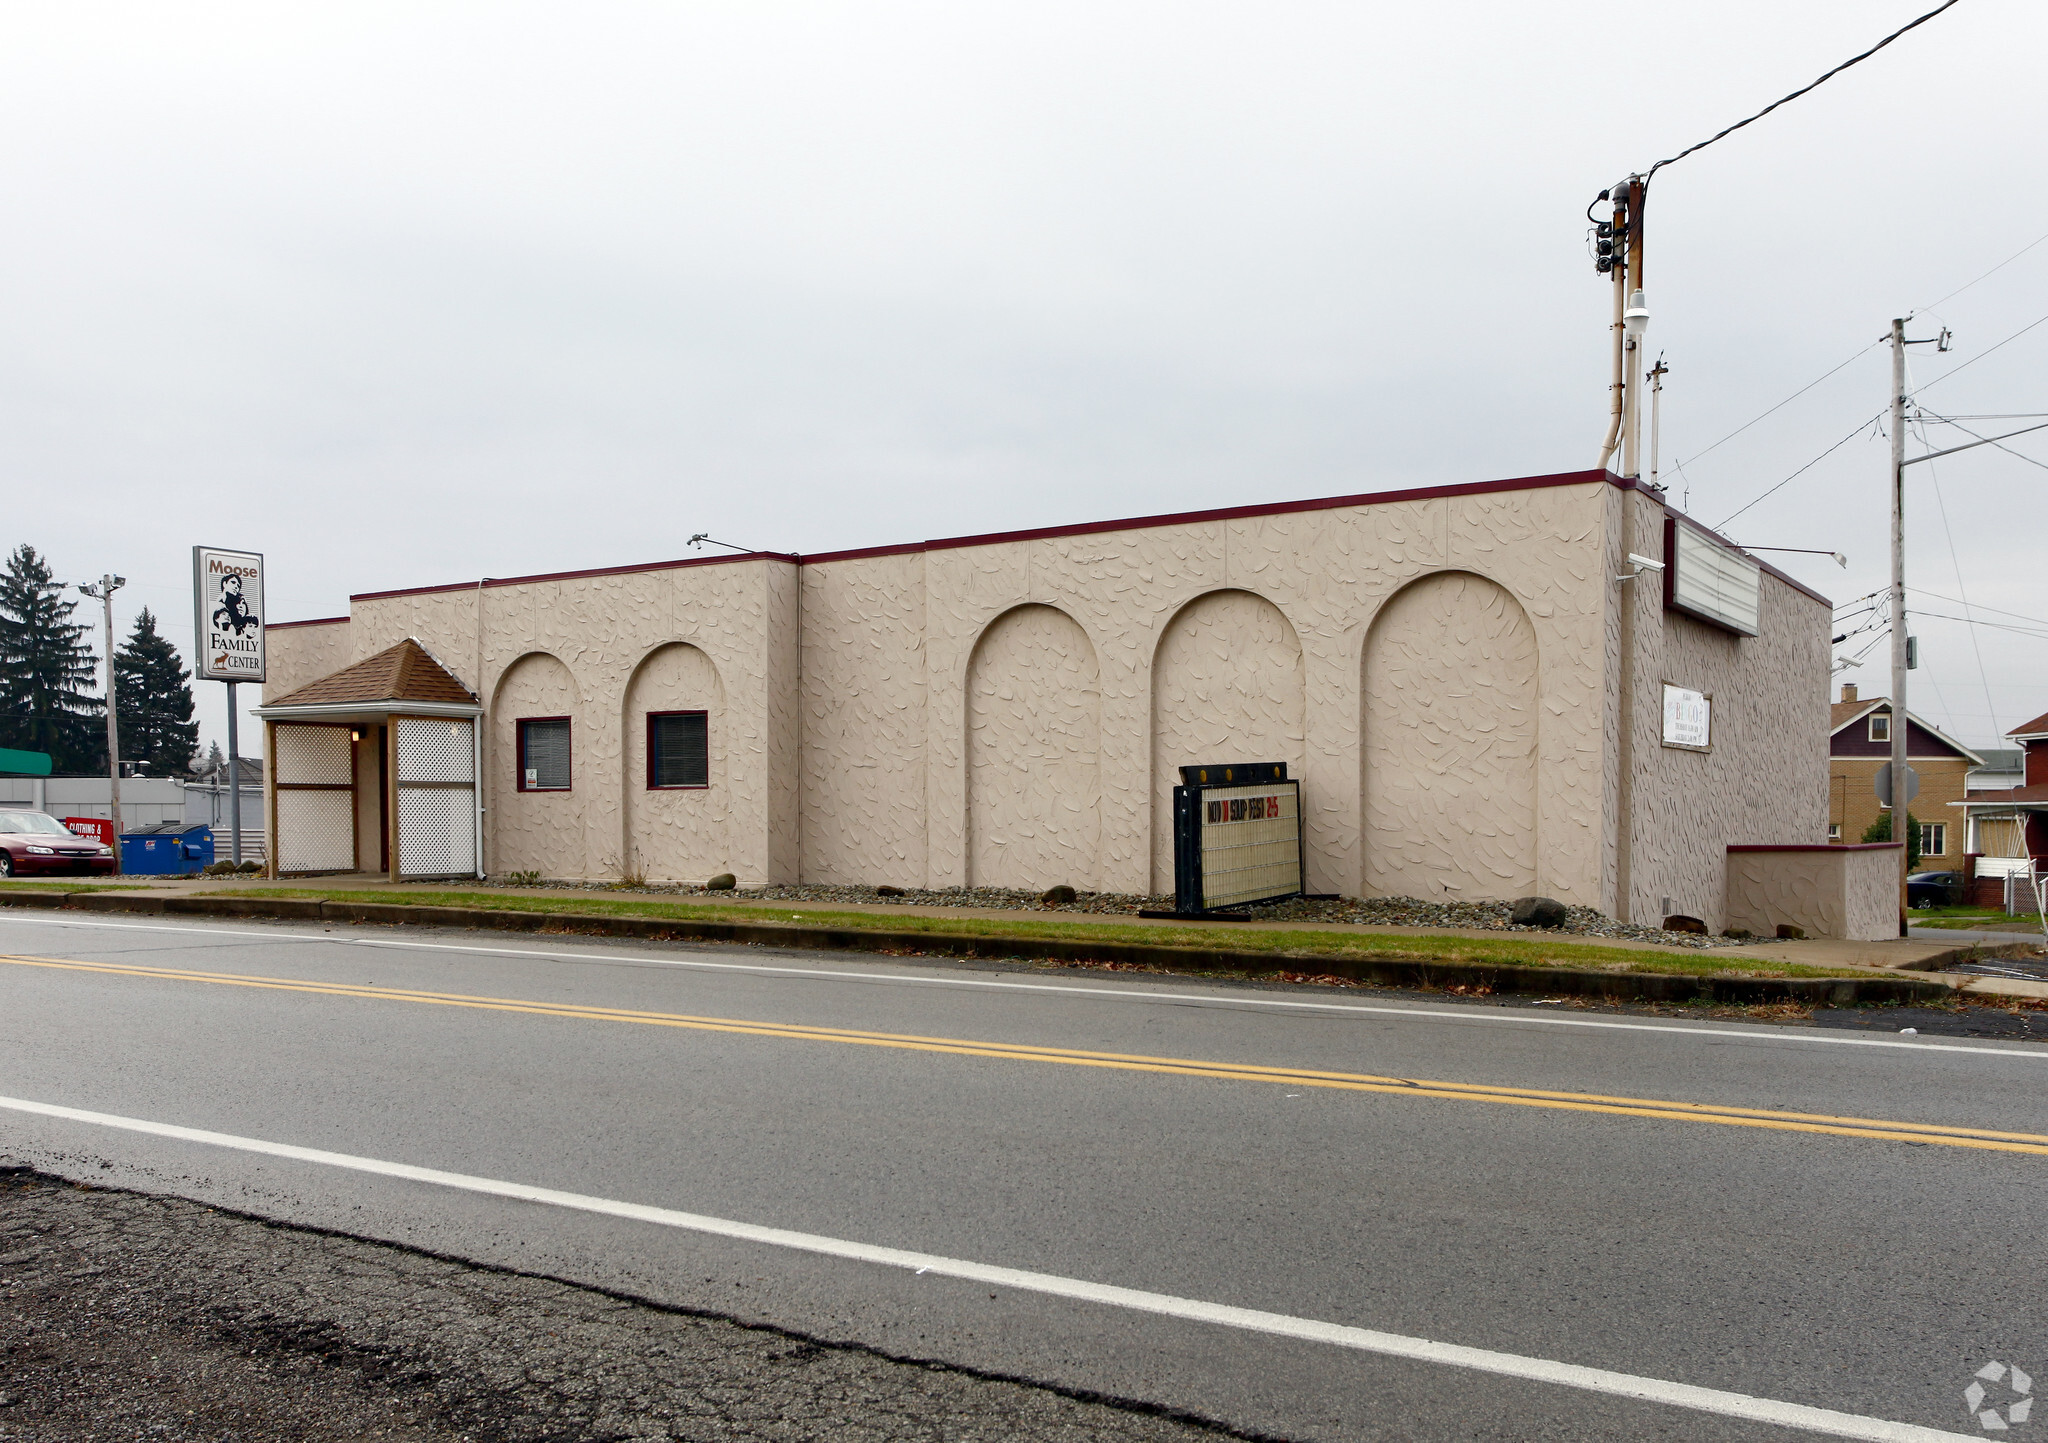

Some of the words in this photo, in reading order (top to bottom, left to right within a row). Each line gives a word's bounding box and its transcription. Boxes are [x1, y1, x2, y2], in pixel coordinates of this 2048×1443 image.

[209, 559, 258, 578] Moose
[211, 633, 259, 652] FAMILY
[228, 655, 260, 669] CENTER
[1230, 799, 1247, 821] SOUP
[1249, 797, 1264, 819] FEST
[1266, 796, 1278, 817] 2-5
[97, 824, 102, 834] &
